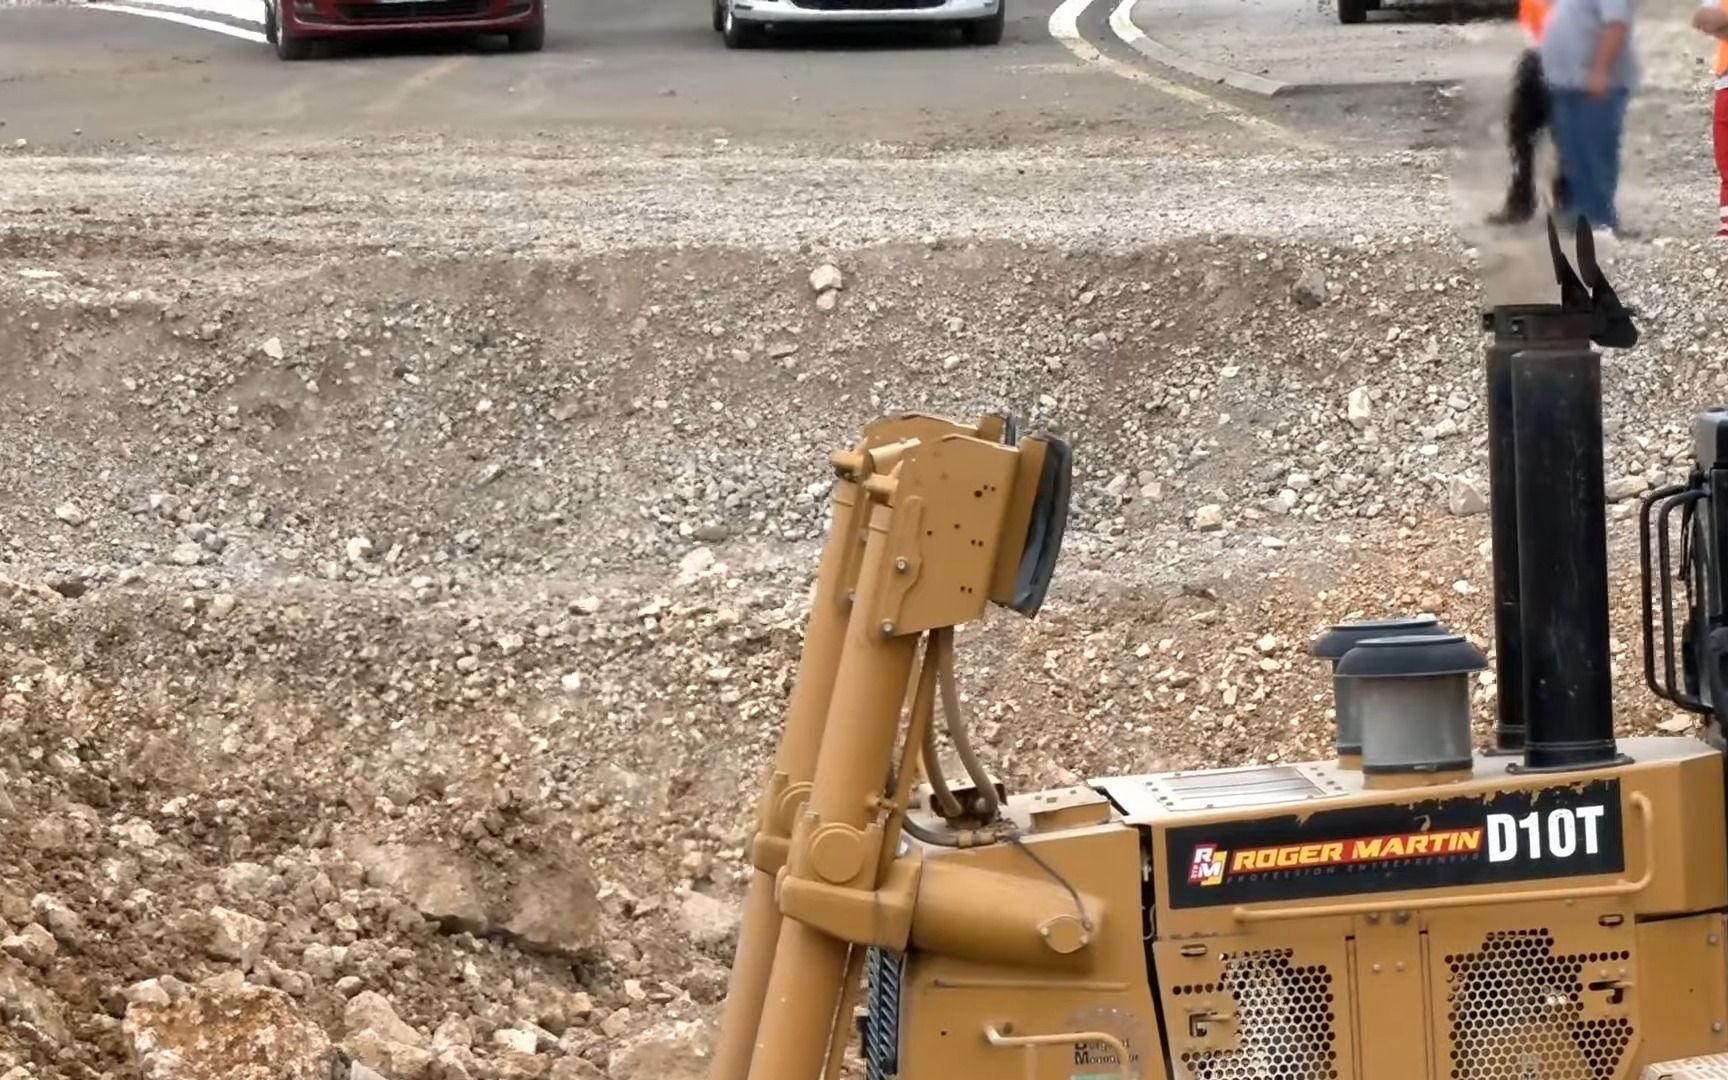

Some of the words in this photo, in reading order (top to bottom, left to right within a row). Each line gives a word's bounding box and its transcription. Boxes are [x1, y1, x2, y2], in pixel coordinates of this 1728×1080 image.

[1232, 842, 1344, 871] ROGER
[1351, 830, 1481, 860] MARTIN
[1486, 805, 1605, 863] D10T
